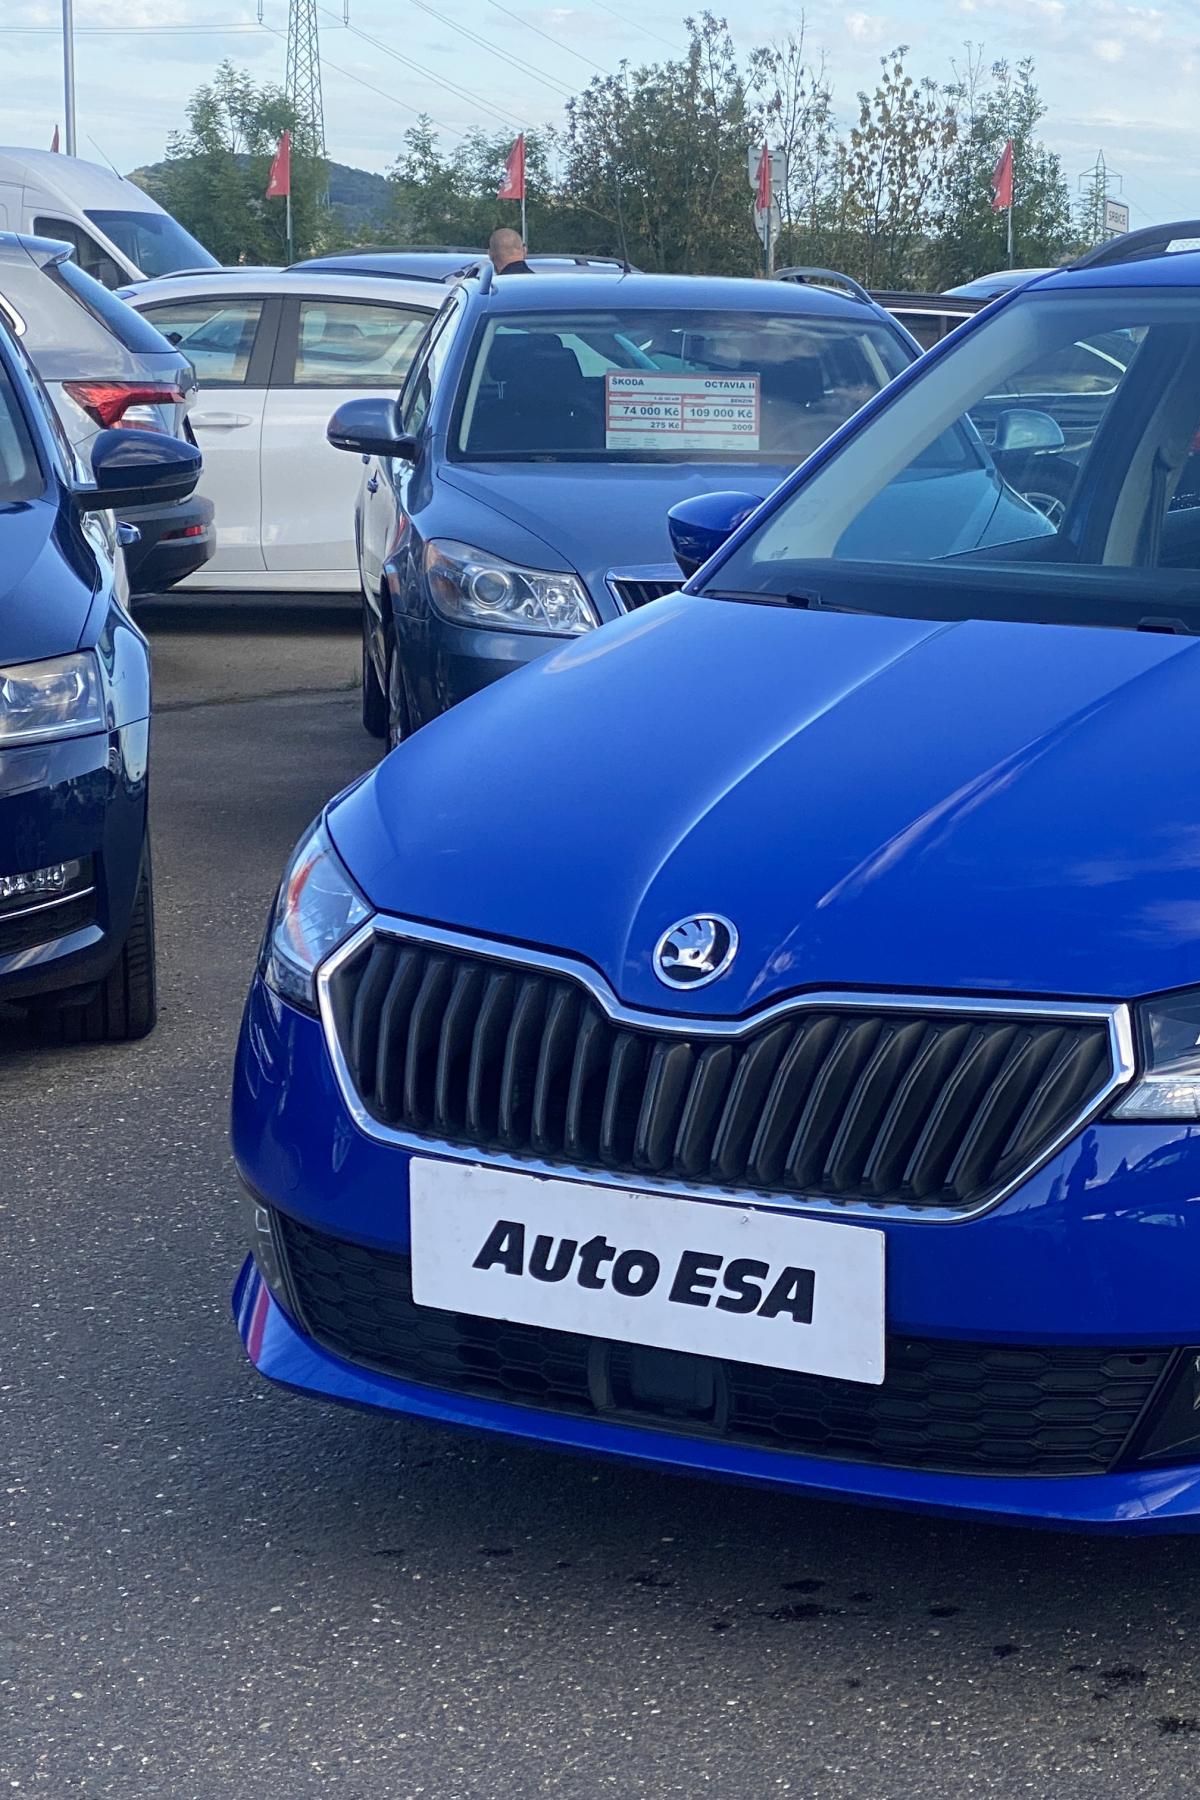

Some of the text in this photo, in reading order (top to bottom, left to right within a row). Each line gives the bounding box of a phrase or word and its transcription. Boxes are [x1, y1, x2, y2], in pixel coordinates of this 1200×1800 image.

[612, 377, 645, 386] ŠKODA
[704, 381, 746, 389] OCTAVIA
[623, 406, 679, 416] 74 000 Kč
[690, 408, 753, 418] 109 000 Kč
[650, 421, 666, 429] 275
[668, 421, 680, 430] Kč
[732, 423, 753, 431] 2009
[472, 1219, 816, 1325] Auto ESA
